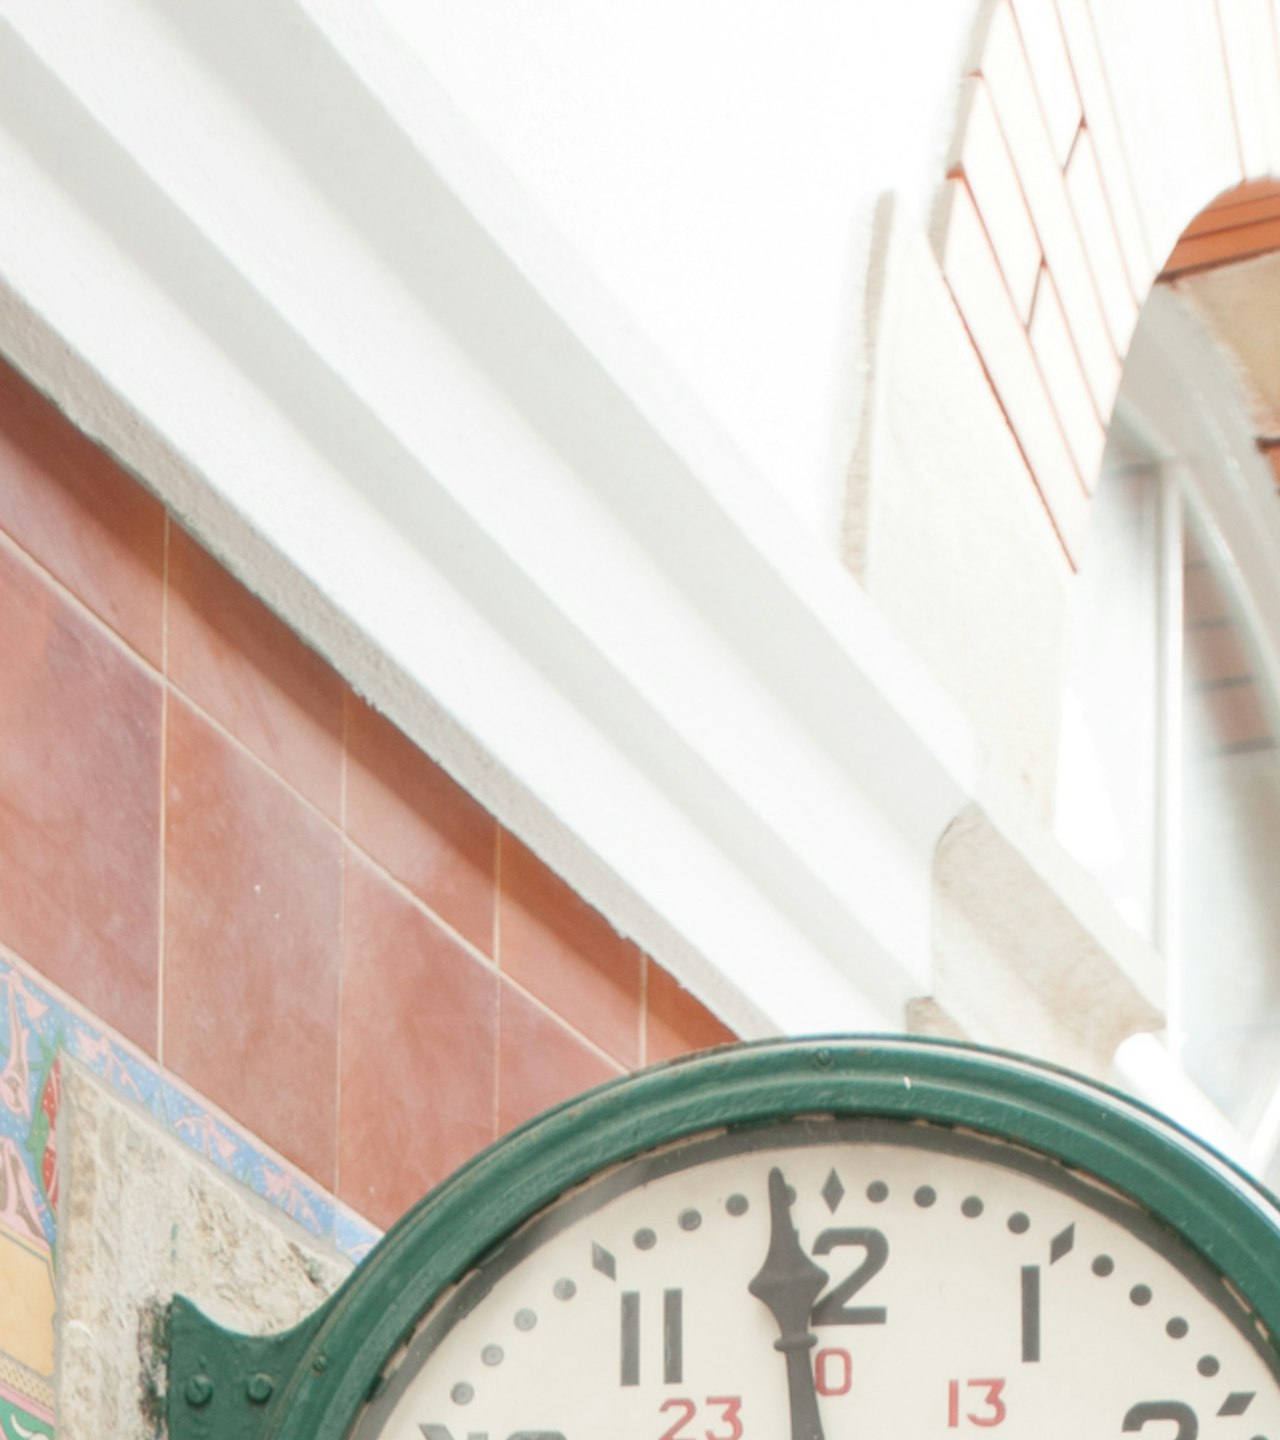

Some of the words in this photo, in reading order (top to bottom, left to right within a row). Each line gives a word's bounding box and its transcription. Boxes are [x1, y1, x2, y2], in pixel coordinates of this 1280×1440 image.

[782, 1226, 889, 1328] 2
[1021, 1265, 1040, 1361] 1
[621, 1289, 682, 1386] 11
[814, 1347, 853, 1397] 0
[948, 1379, 1006, 1428] 13
